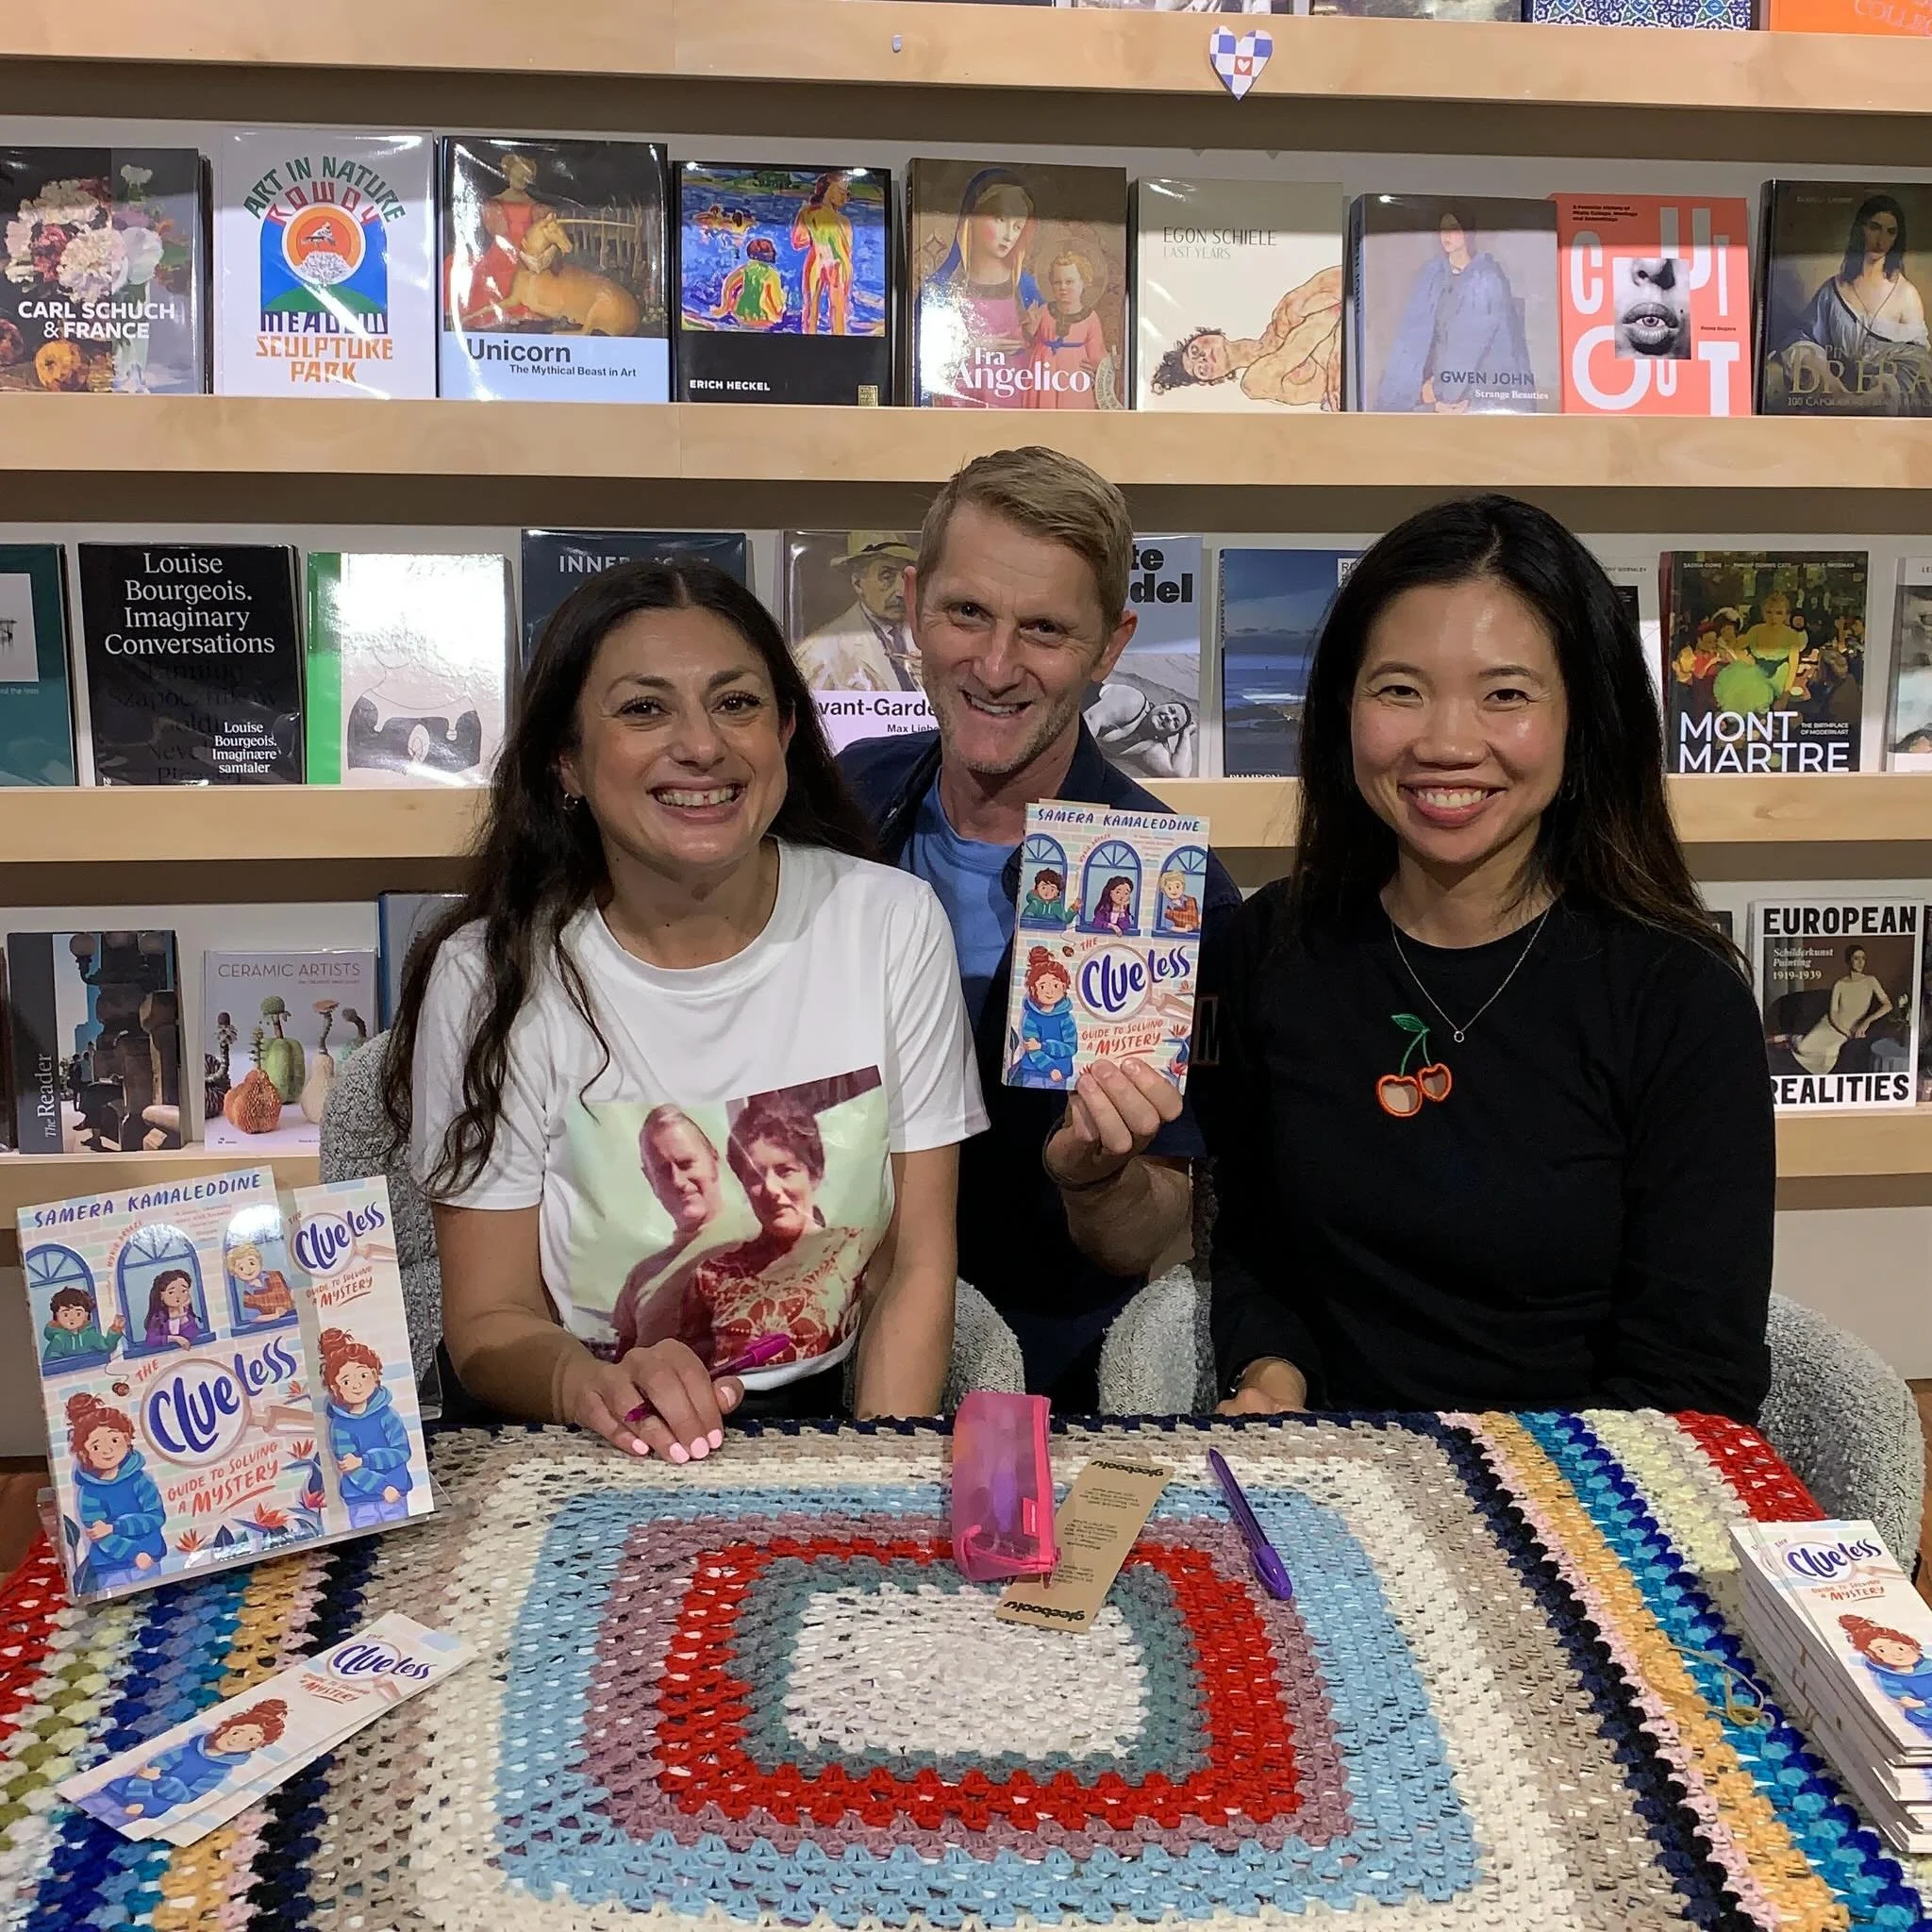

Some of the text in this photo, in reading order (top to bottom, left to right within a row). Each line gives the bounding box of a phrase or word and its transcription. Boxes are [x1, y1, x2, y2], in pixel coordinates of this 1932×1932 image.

[242, 156, 407, 223] ART IN NATURE
[1162, 226, 1277, 246] EGON SCHIELE
[1162, 246, 1231, 259] LAST YEARS
[18, 301, 175, 320] CARL SCHUCH
[43, 322, 150, 340] & FRANCE
[260, 311, 389, 334] MEADW
[256, 336, 393, 359] SCULPTURE
[466, 339, 571, 362] Unicorn
[974, 347, 1006, 366] Fra
[291, 361, 357, 383] PARK
[509, 364, 637, 377] The Mythical Beast in Art
[952, 361, 1091, 399] Angelico
[1441, 371, 1535, 386] GWEN JOHN
[690, 379, 771, 391] ERICH HECKEL
[1475, 390, 1549, 400] Strange Beauties
[143, 552, 223, 575] Louise
[125, 579, 252, 605] Bourgeois.
[1130, 574, 1192, 603] del
[125, 607, 251, 632] Imaginary
[105, 633, 275, 656] Conversations
[225, 722, 264, 734] Louise
[887, 724, 908, 733] Max
[1681, 711, 1798, 741] MONT
[214, 735, 277, 748] Bourgeois.
[212, 748, 277, 762] Imaginære
[1679, 742, 1850, 773] MARTRE
[218, 762, 271, 774] samtaler
[1038, 808, 1200, 832] SAMERA KAMALEDDINE
[1763, 907, 1916, 935] EUROPEAN
[1080, 937, 1098, 951] THE
[218, 963, 360, 977] CERAMIC ARTISTS
[1774, 958, 1811, 968] Painting
[1774, 970, 1822, 980] 1919-1939
[1082, 1020, 1163, 1041] GUIDE TO SOLVING
[1087, 1033, 1161, 1056] A MYSTERY
[34, 1053, 57, 1137] The Reader
[35, 1174, 261, 1227] SAMERA KAMALEDDINE
[321, 1276, 373, 1307] MYSTERY
[136, 1358, 158, 1381] THE
[168, 1441, 278, 1501] GUIDE TO SOLVING
[178, 1459, 278, 1517] A MYSTERY
[1830, 1586, 1885, 1601] MYSTERY
